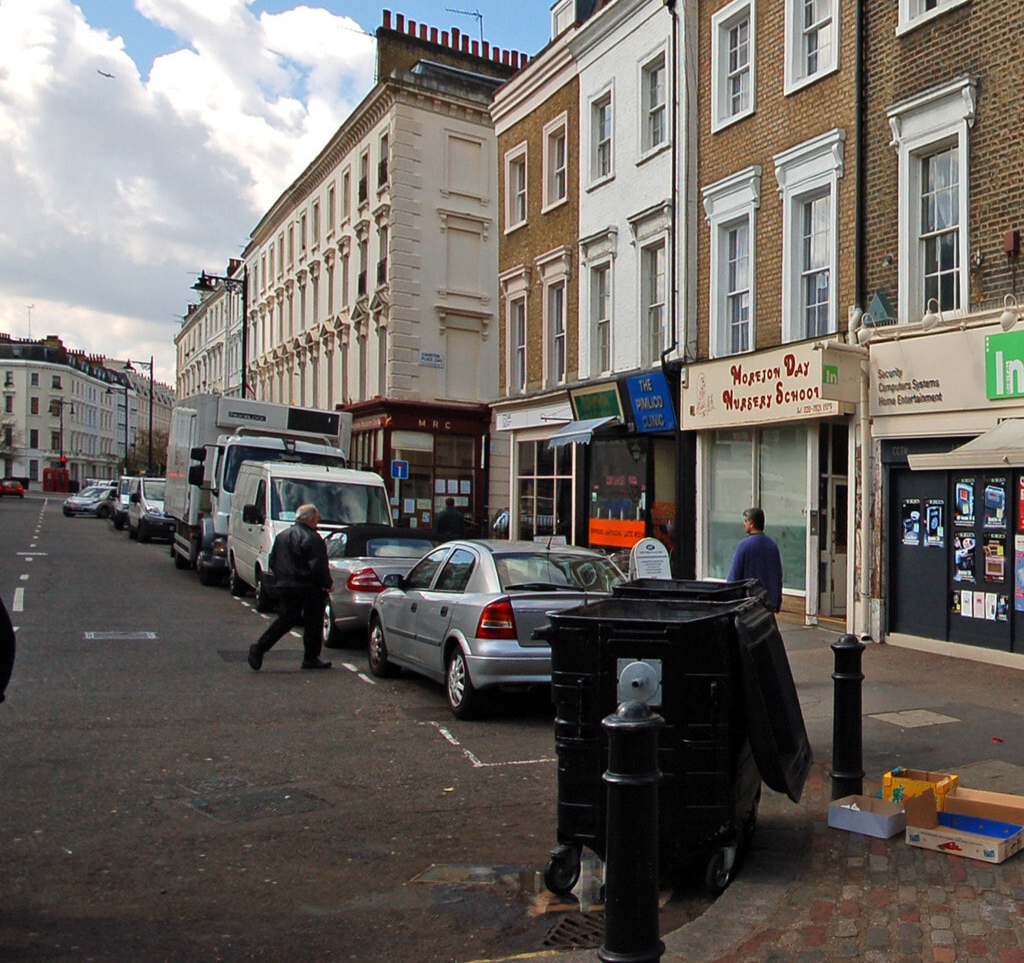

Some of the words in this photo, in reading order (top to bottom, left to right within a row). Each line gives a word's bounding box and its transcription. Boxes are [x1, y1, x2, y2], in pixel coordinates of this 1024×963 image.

[784, 354, 810, 377] DAY
[826, 370, 837, 384] In
[878, 367, 902, 379] Security
[639, 379, 652, 392] THE
[878, 382, 911, 393] Computers
[912, 378, 940, 390] Systems
[636, 396, 663, 410] PIMLICO
[722, 390, 772, 411] NURSERY
[878, 395, 896, 406] Home
[897, 392, 942, 405] Entertainment
[642, 414, 664, 428] CLINIC
[892, 446, 908, 455] CCTV
